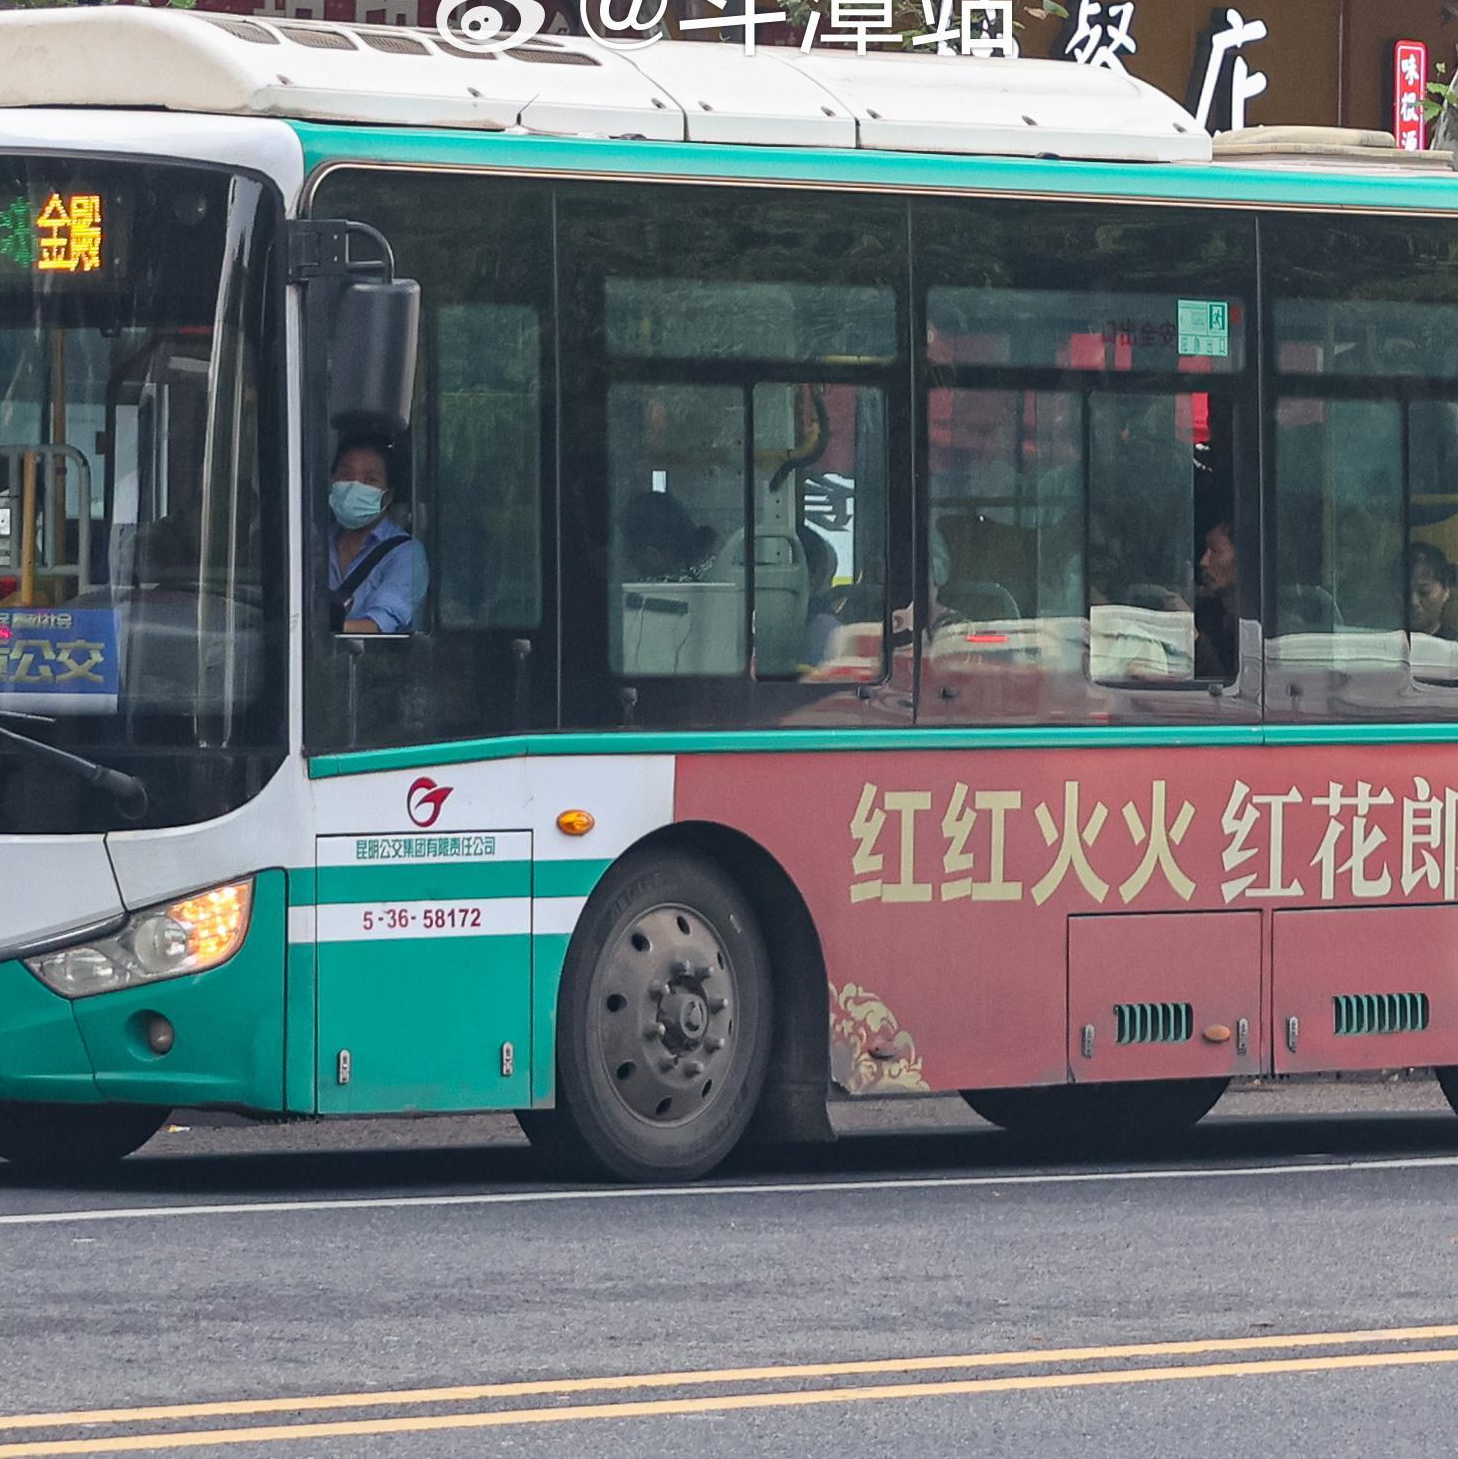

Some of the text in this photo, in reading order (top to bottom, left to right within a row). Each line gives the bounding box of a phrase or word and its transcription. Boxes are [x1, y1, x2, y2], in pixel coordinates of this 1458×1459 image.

[355, 835, 496, 861] 昆明公交集团有限责任公司
[848, 779, 1197, 905] 红红火火
